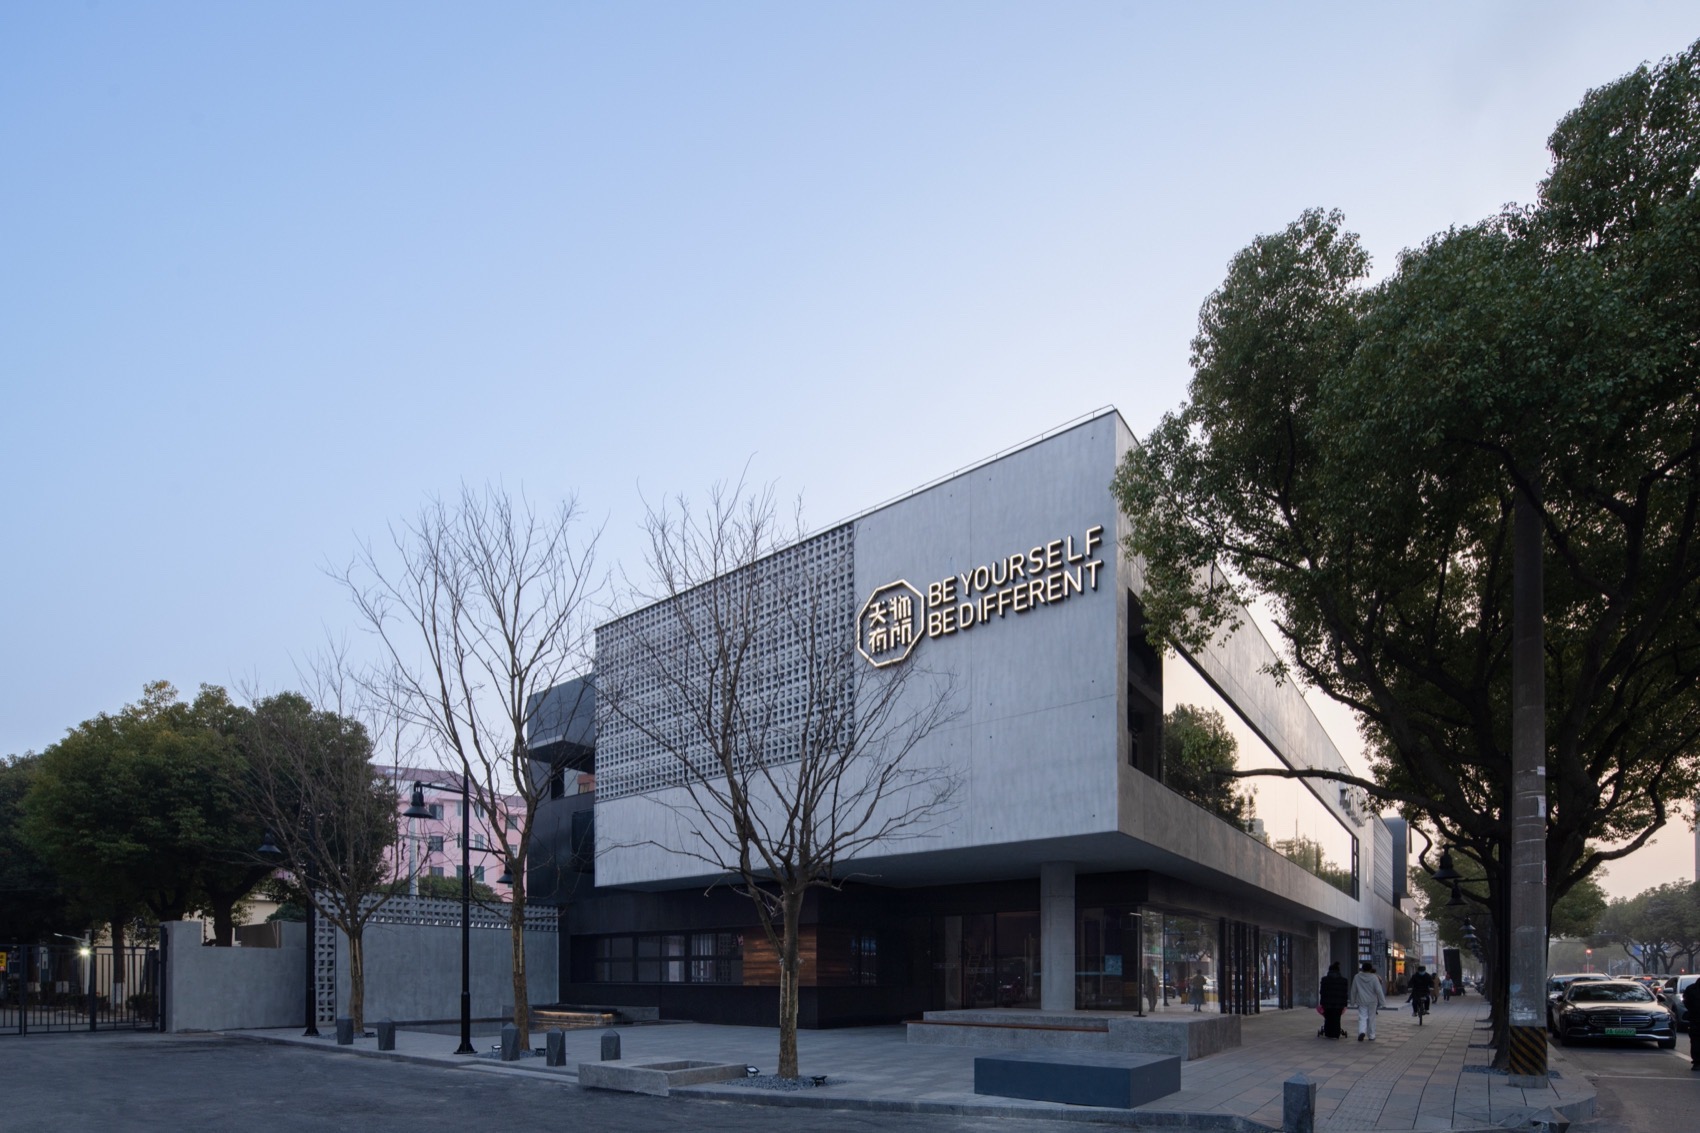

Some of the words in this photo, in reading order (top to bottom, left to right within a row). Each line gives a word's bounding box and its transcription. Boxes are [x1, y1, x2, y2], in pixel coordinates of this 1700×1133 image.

[928, 576, 957, 608] BE
[961, 525, 1102, 596] YOURSELF
[928, 607, 957, 638] BE
[959, 560, 1102, 629] DIFFERENT
